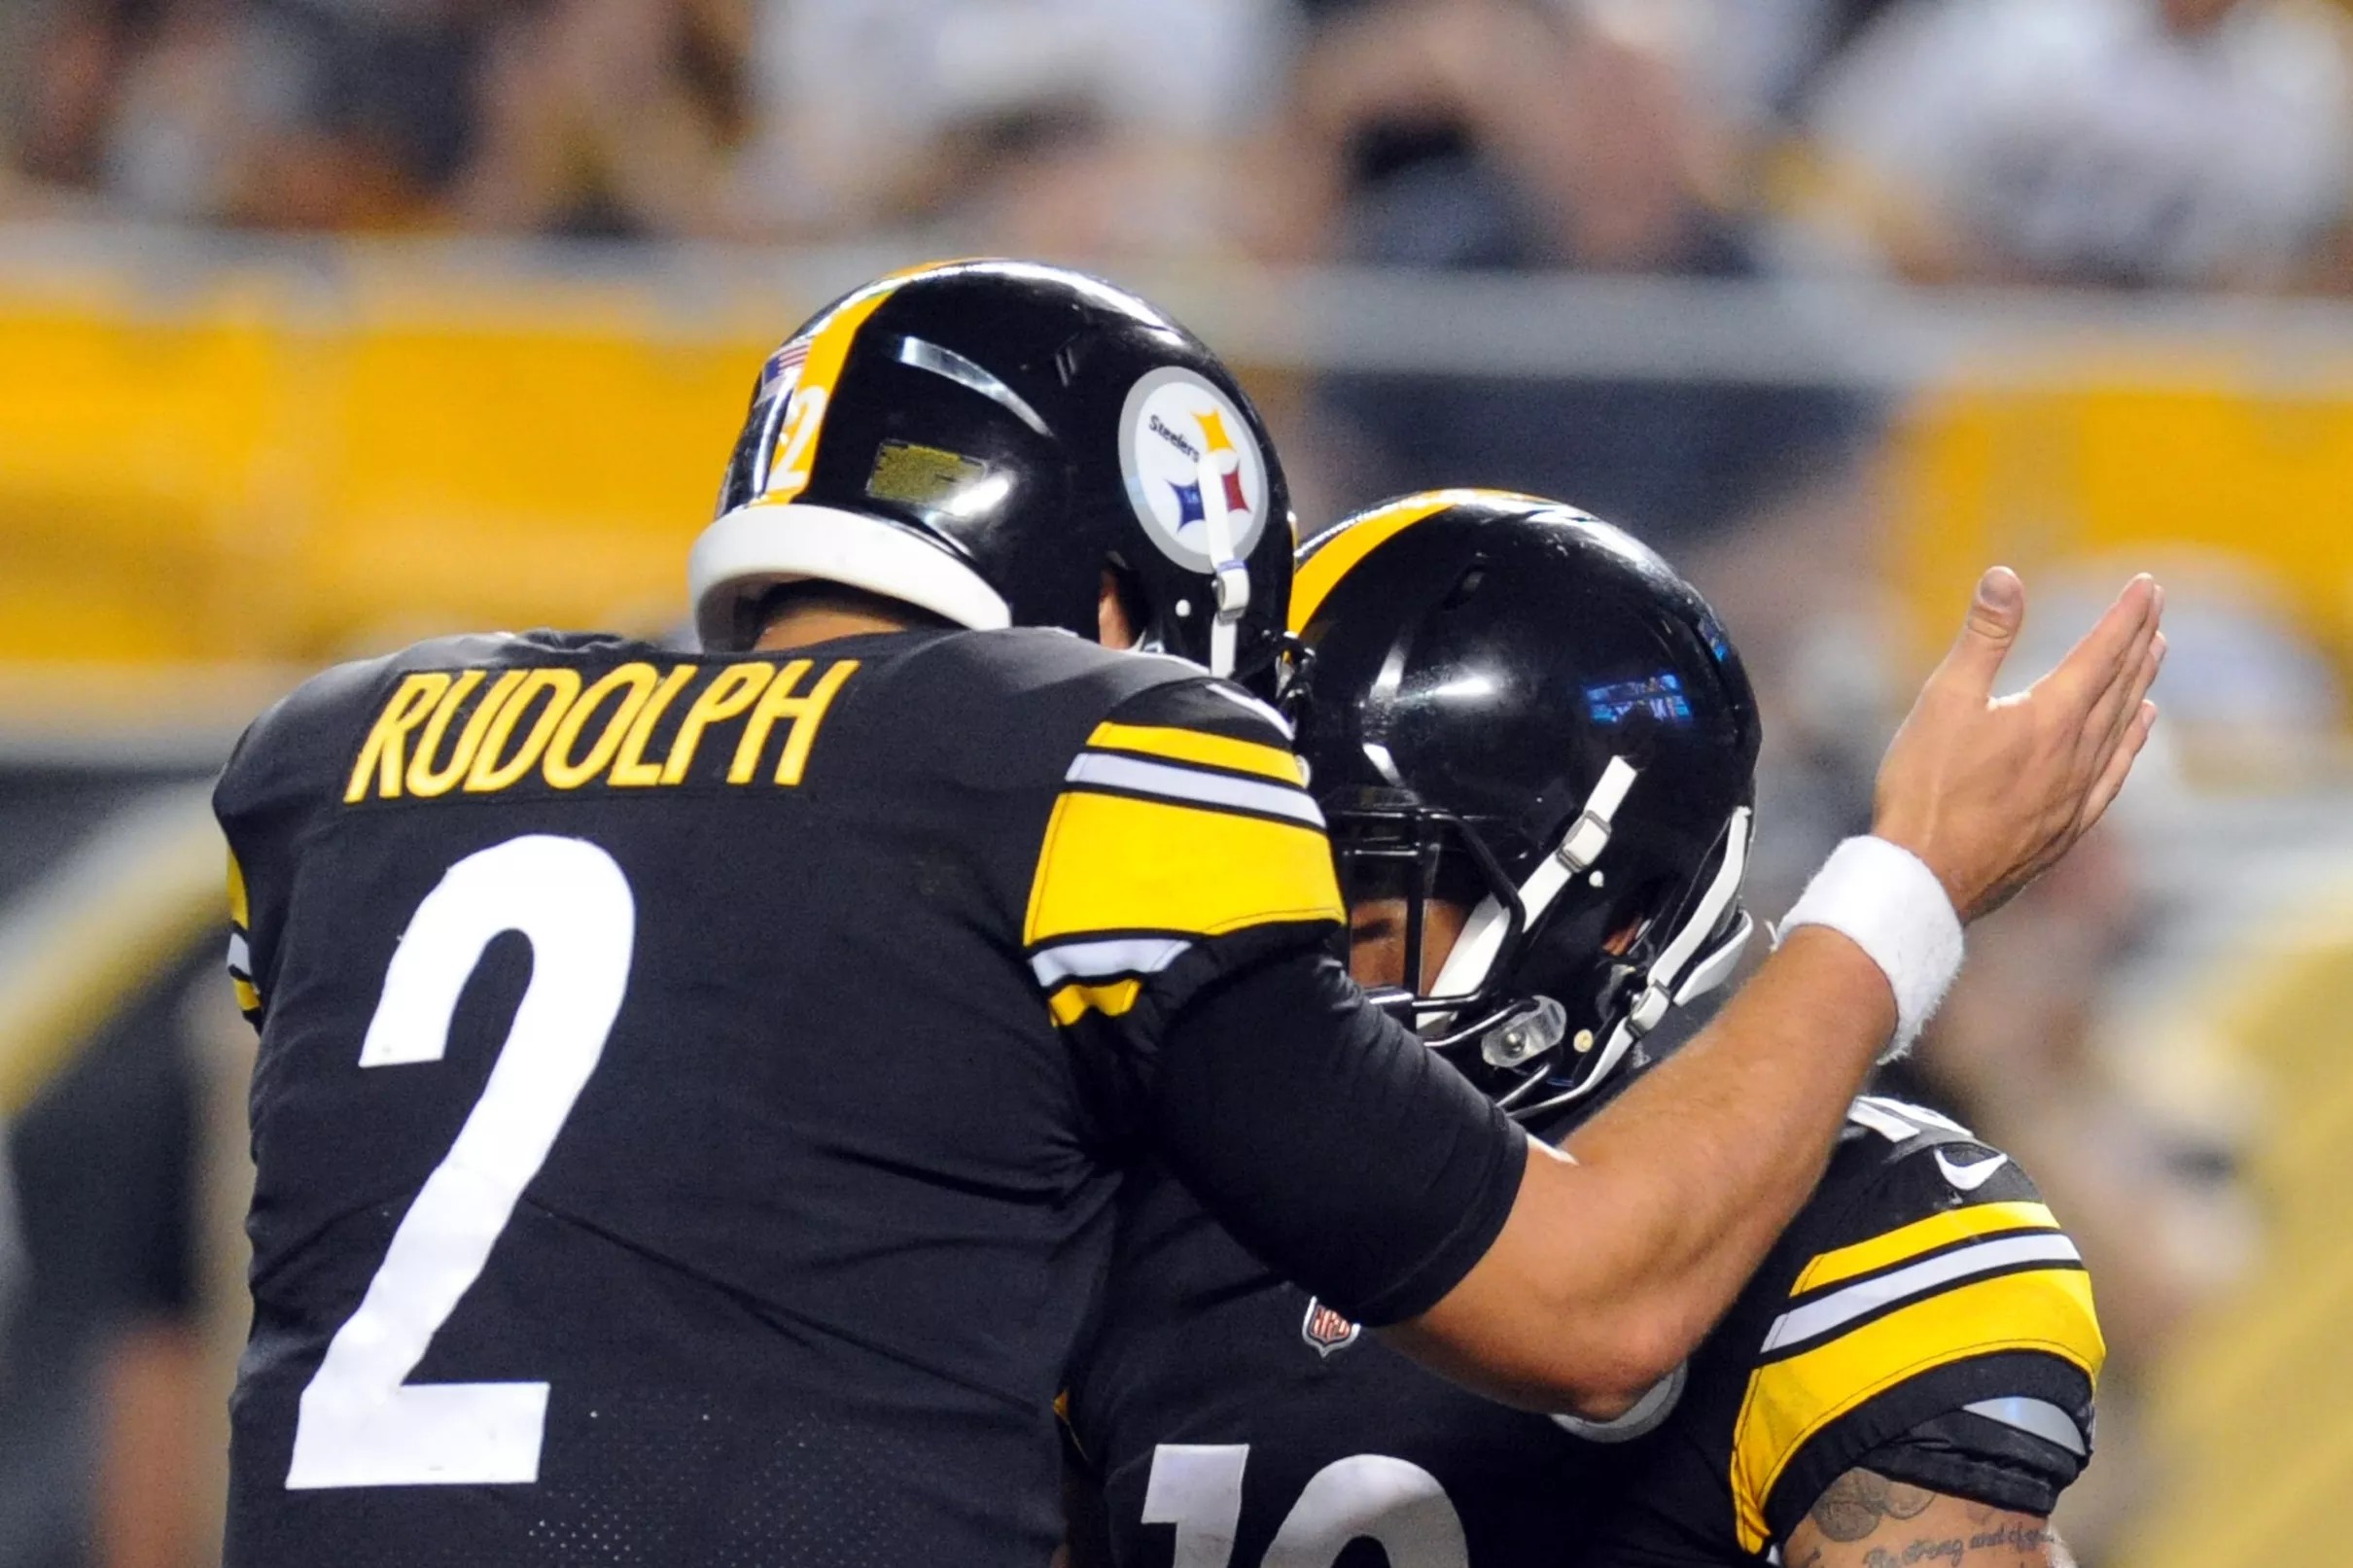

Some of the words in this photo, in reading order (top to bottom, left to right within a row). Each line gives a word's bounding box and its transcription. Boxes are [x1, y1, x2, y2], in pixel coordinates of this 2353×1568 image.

[767, 386, 827, 491] 2
[1148, 414, 1201, 463] Steelers
[342, 658, 861, 805] RUDOLPH
[285, 833, 636, 1490] 2
